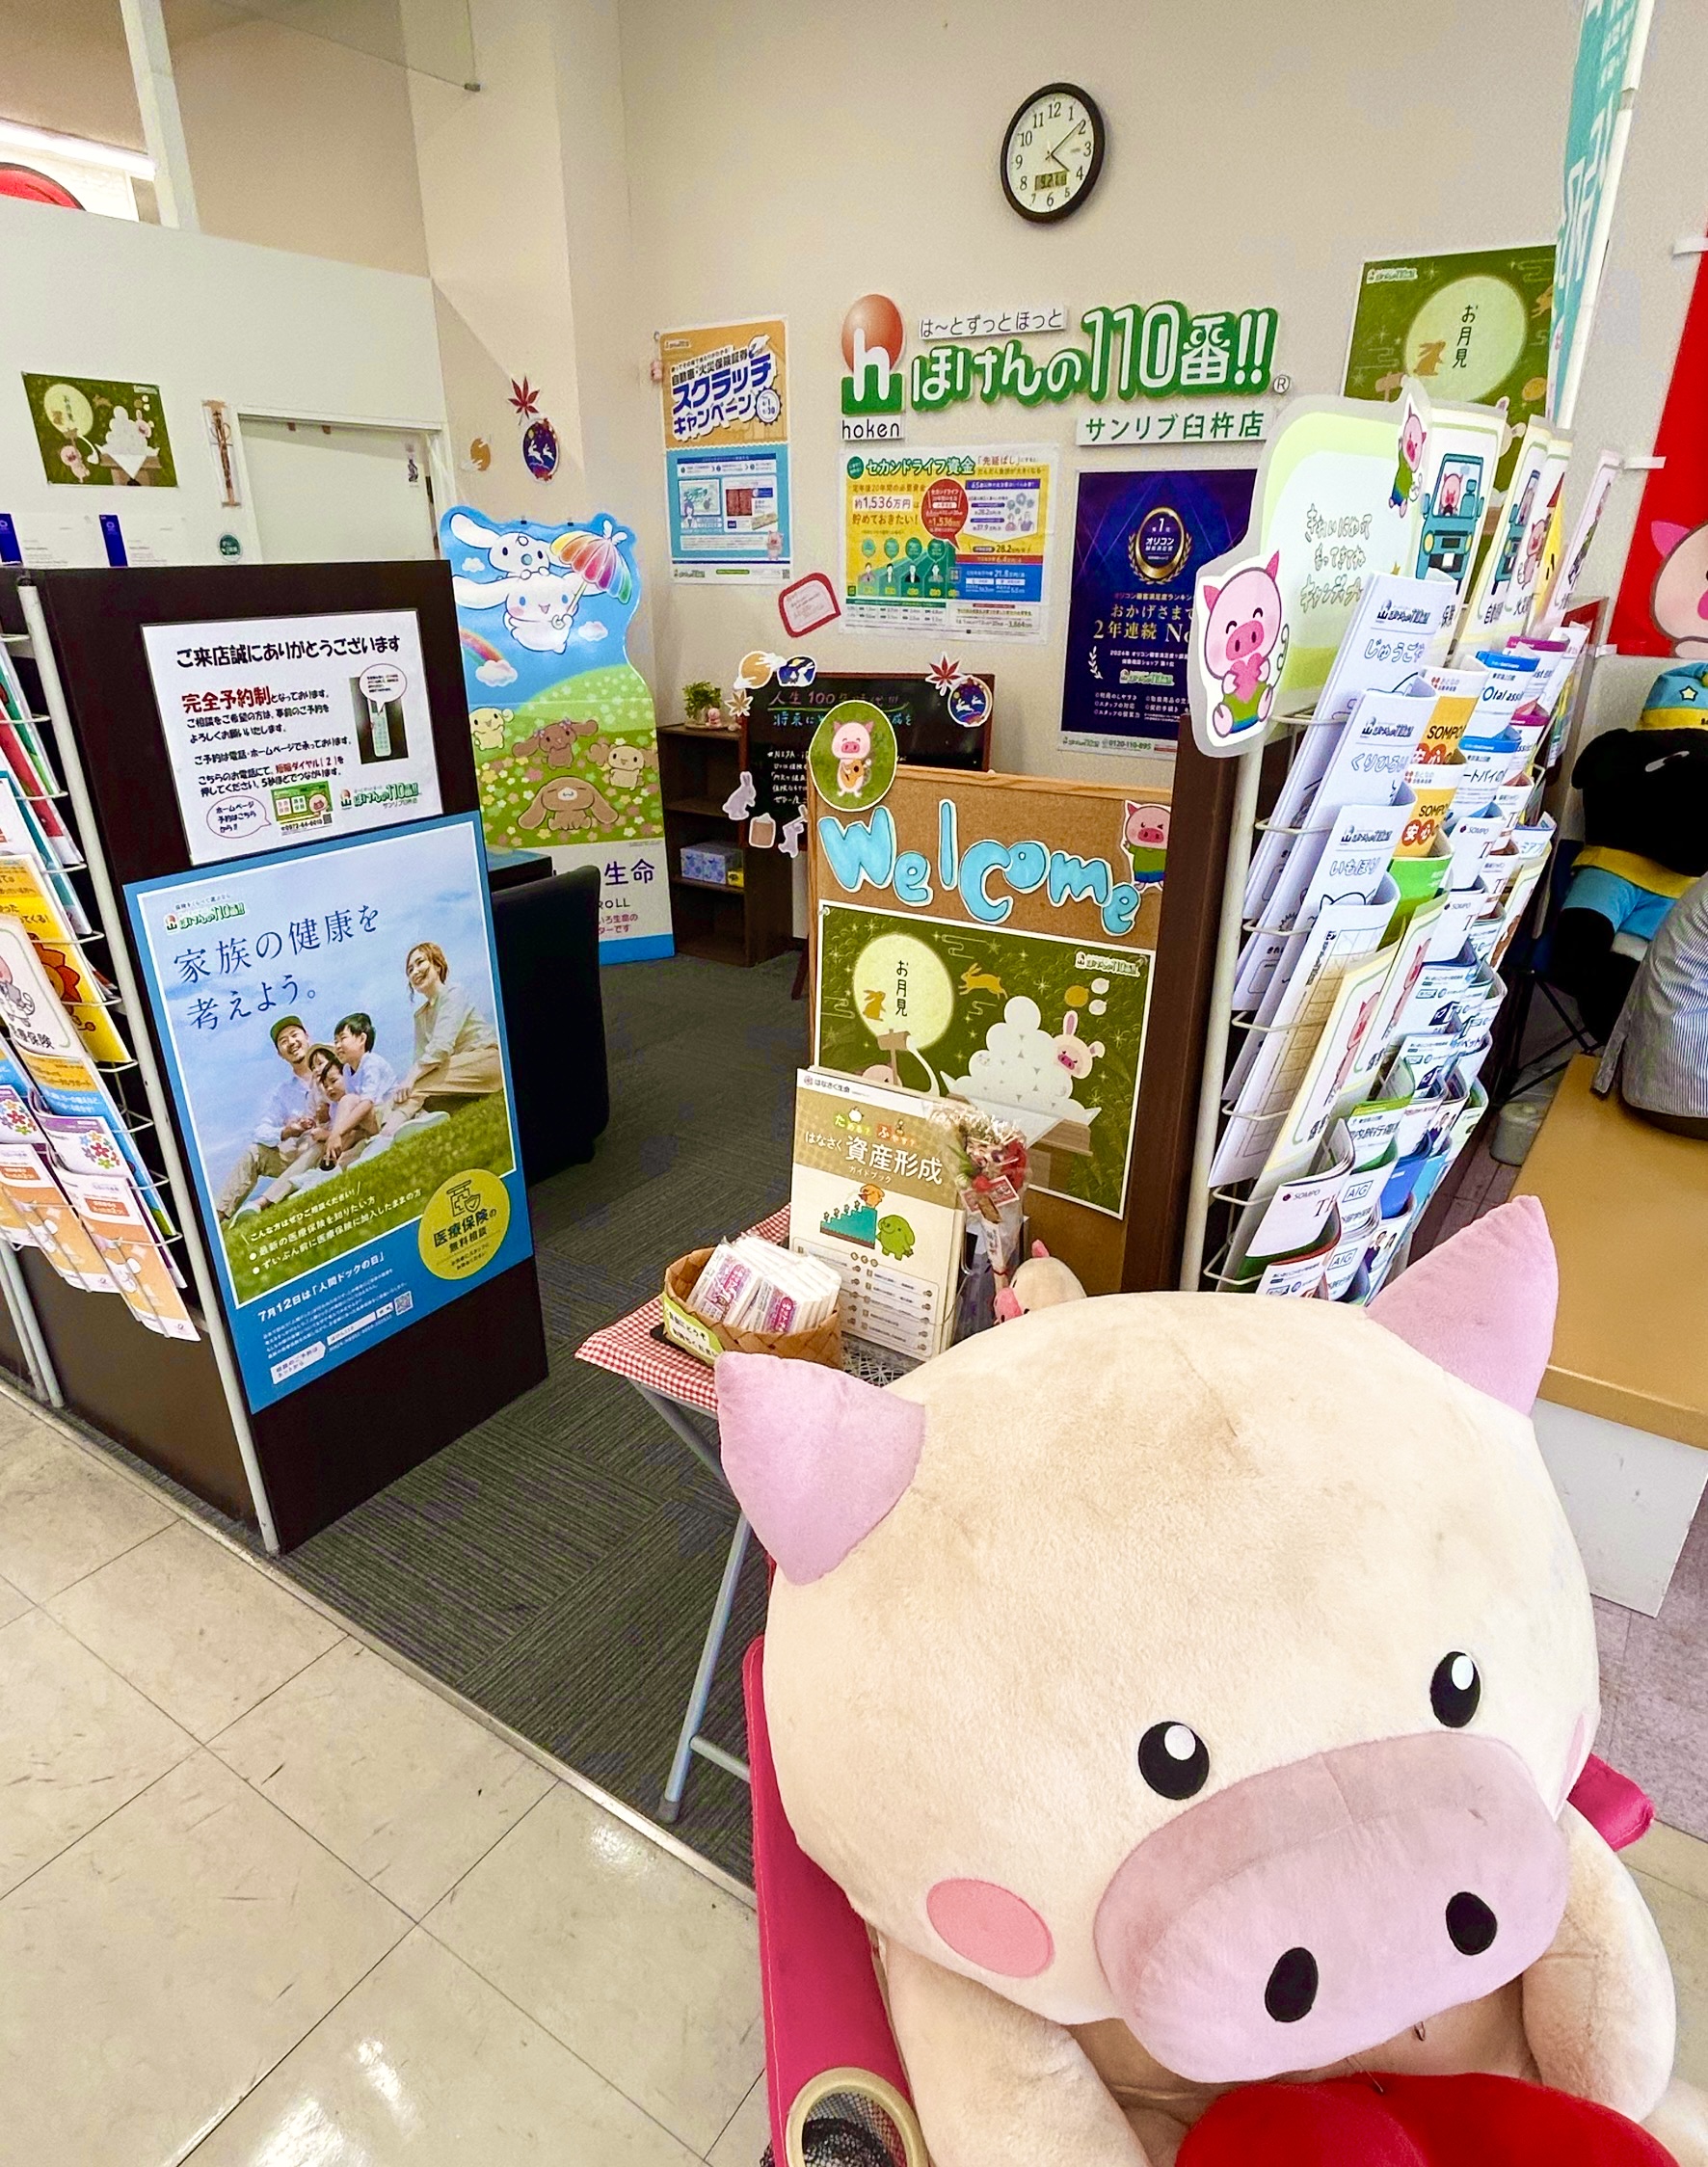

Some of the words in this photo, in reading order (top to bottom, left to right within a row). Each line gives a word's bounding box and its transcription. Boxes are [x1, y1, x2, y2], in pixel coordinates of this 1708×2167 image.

[1033, 112, 1044, 128] 11
[1048, 101, 1061, 120] 12
[1068, 106, 1074, 121] 1
[1079, 120, 1086, 135] 2
[1018, 130, 1032, 147] 10
[1083, 142, 1091, 157] 3
[1015, 154, 1023, 171] 9
[1020, 175, 1027, 191] 8
[1076, 166, 1083, 181] 4
[1031, 194, 1036, 204] 7
[1046, 192, 1054, 207] 6
[1064, 187, 1071, 199] 5
[1453, 305, 1478, 368] お月見
[912, 302, 1276, 407] ほけんの110番!!
[673, 354, 772, 415] スクラッチ
[674, 393, 752, 435] キャンペーン
[841, 417, 901, 441] hoken
[1085, 410, 1265, 441] サンリブ臼杵店
[867, 456, 975, 476] セカンドライフ資金
[1145, 537, 1174, 546] オリコン
[1093, 620, 1157, 640] 2年連続
[176, 635, 400, 668] ご来店誠にありがとうございます
[182, 685, 329, 714] 完全予約制となっております。
[216, 801, 254, 815] ホームページ
[1467, 826, 1489, 835] SOMPO
[604, 858, 654, 886] 生命
[817, 799, 1142, 936] Welcome
[174, 904, 379, 983] 家族の健康を
[895, 960, 909, 1018] お月見
[187, 975, 316, 1030] 考えよう。
[805, 1131, 843, 1152] はなさく
[845, 1135, 943, 1186] 資産形成
[848, 1165, 892, 1184] ガイドブック
[1293, 1190, 1321, 1200] SOMPO
[1348, 1185, 1369, 1195] AIG
[259, 1195, 376, 1256] 最新の医療保険を知りたい方
[434, 1209, 497, 1247] 医療保険の
[449, 1226, 487, 1252] 無料相談
[1333, 1254, 1353, 1265] AIG
[258, 1251, 385, 1322] 7月12日は「人間ドックの日」
